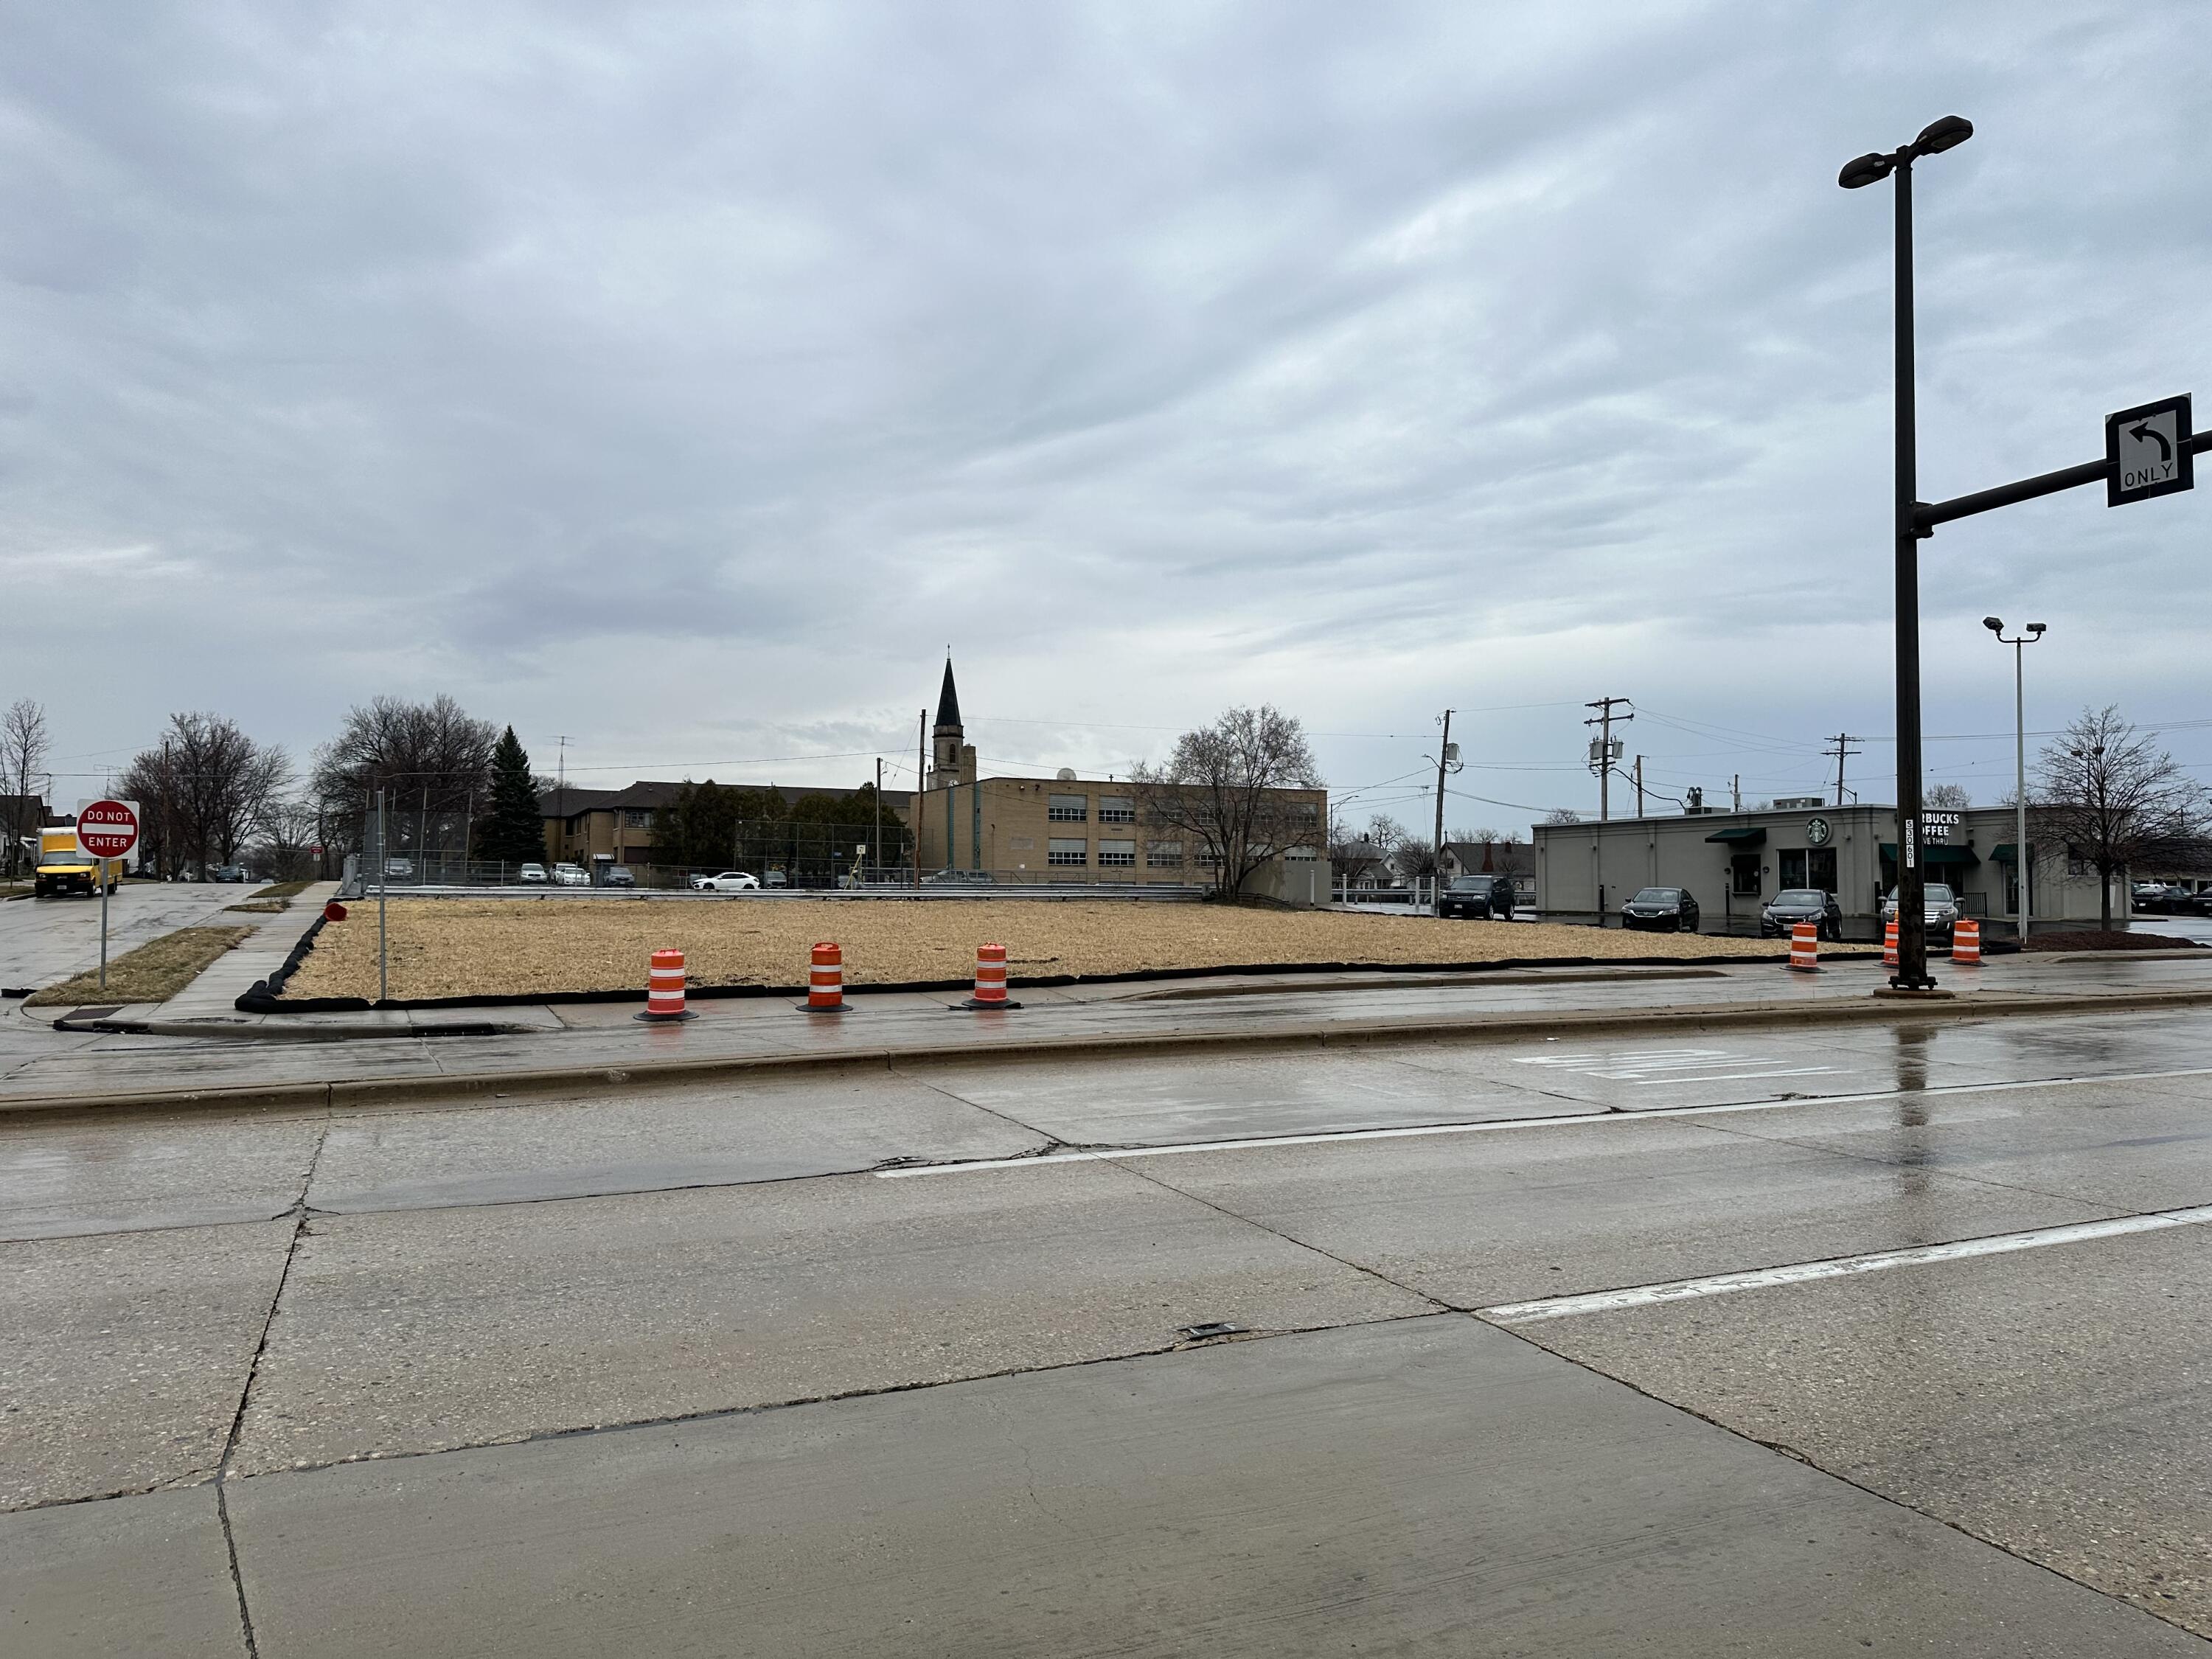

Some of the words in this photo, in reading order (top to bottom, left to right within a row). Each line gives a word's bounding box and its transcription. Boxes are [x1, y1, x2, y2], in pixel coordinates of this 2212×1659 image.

[2125, 462, 2173, 487] ONLY
[88, 811, 103, 821] DO
[107, 812, 131, 821] NOT
[1922, 825, 1949, 835] FFEE
[88, 837, 127, 847] ENTER
[1933, 838, 1948, 846] THRU
[1512, 1048, 1860, 1084] ONLY
